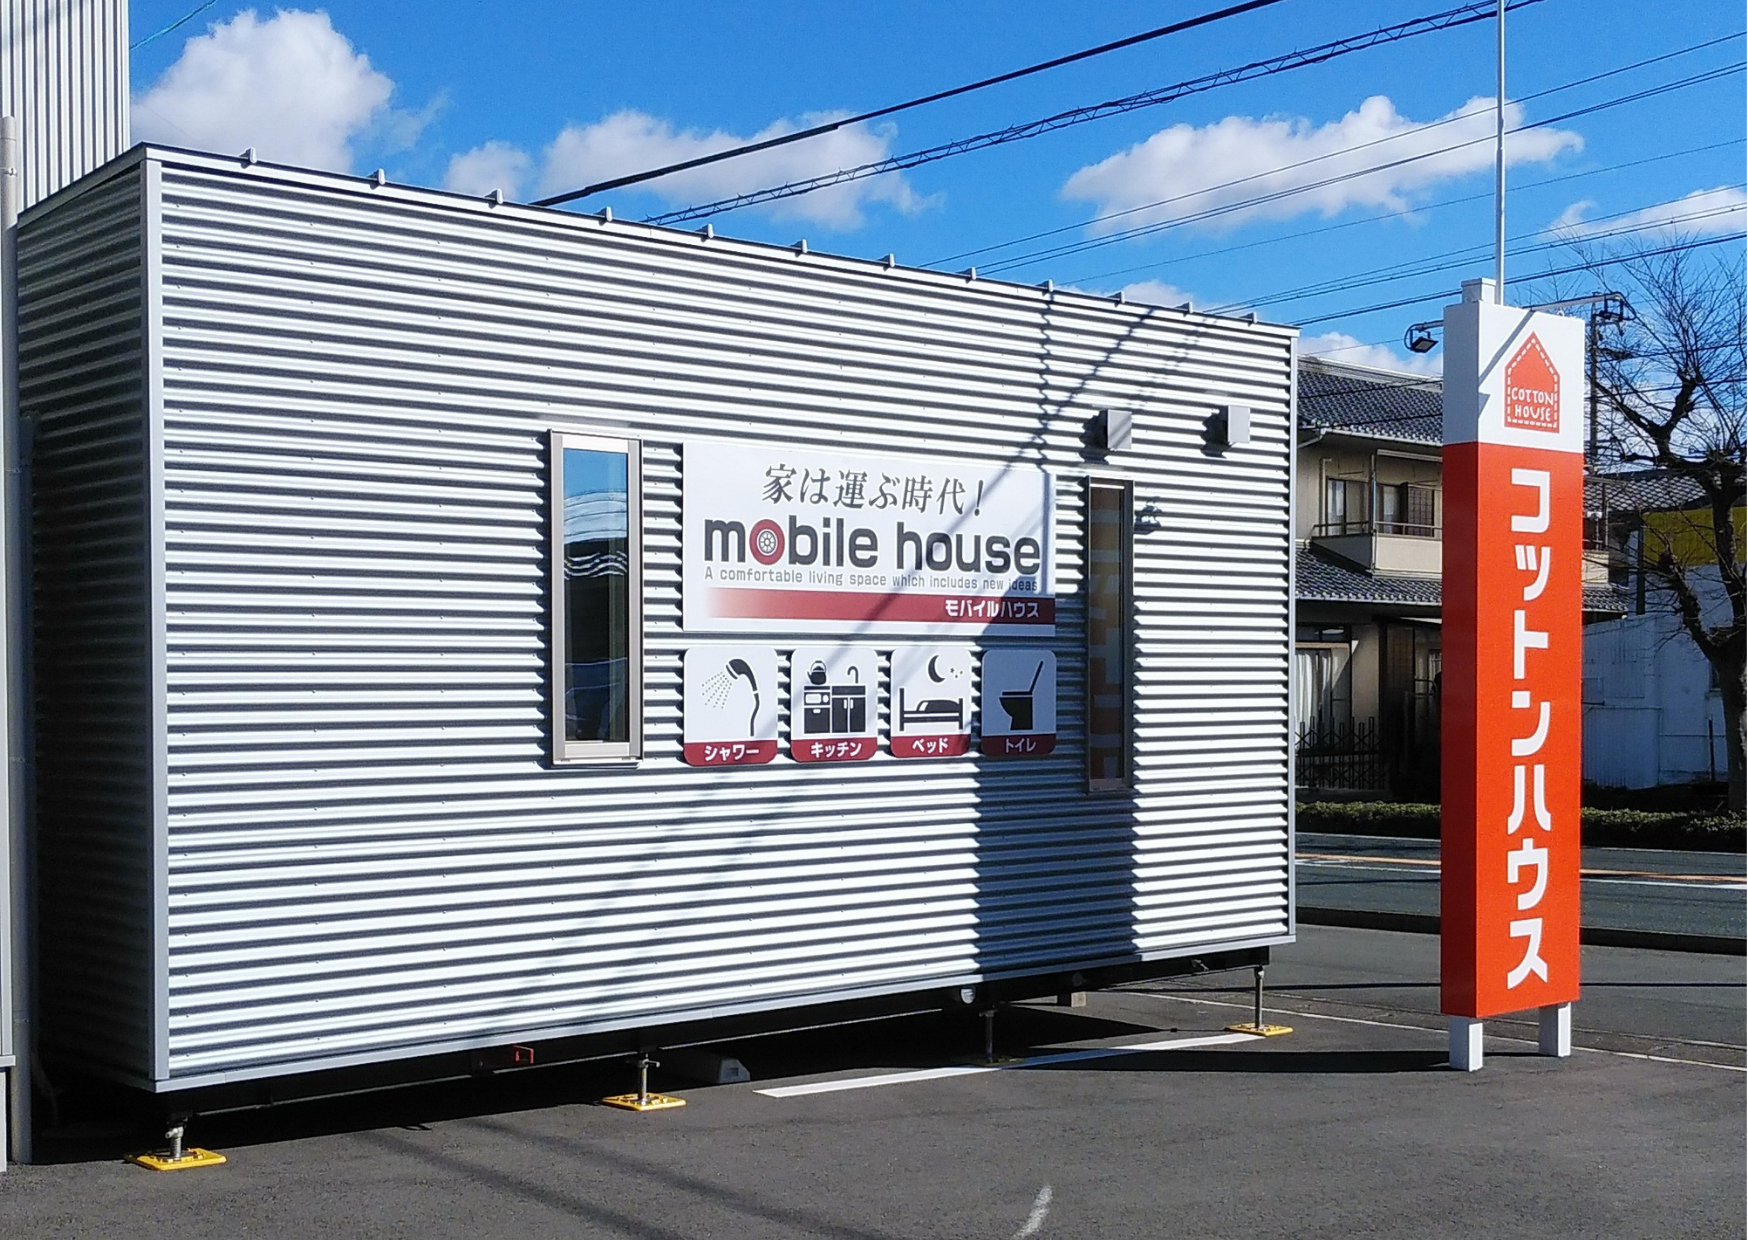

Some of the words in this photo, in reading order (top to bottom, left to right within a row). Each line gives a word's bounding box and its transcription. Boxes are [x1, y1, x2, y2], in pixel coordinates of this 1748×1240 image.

[1511, 387, 1554, 405] COTTON
[1514, 404, 1551, 421] HOUSE
[762, 463, 984, 516] 家は運ぶ時代!
[704, 515, 878, 568] mobile
[896, 521, 1041, 575] house
[705, 566, 713, 580] A
[720, 569, 803, 583] comfortable
[808, 571, 843, 586] living
[849, 574, 886, 587] space
[892, 574, 925, 587] which
[929, 576, 978, 589] includes
[983, 578, 1004, 590] new
[1008, 578, 1038, 592] ideas
[945, 599, 1040, 618] モバイルハウス
[1507, 468, 1552, 990] コットンハウス
[704, 744, 760, 761] シャワー
[810, 741, 863, 758] キッチン
[911, 737, 949, 754] ベッド
[1004, 738, 1036, 753] トイレ
